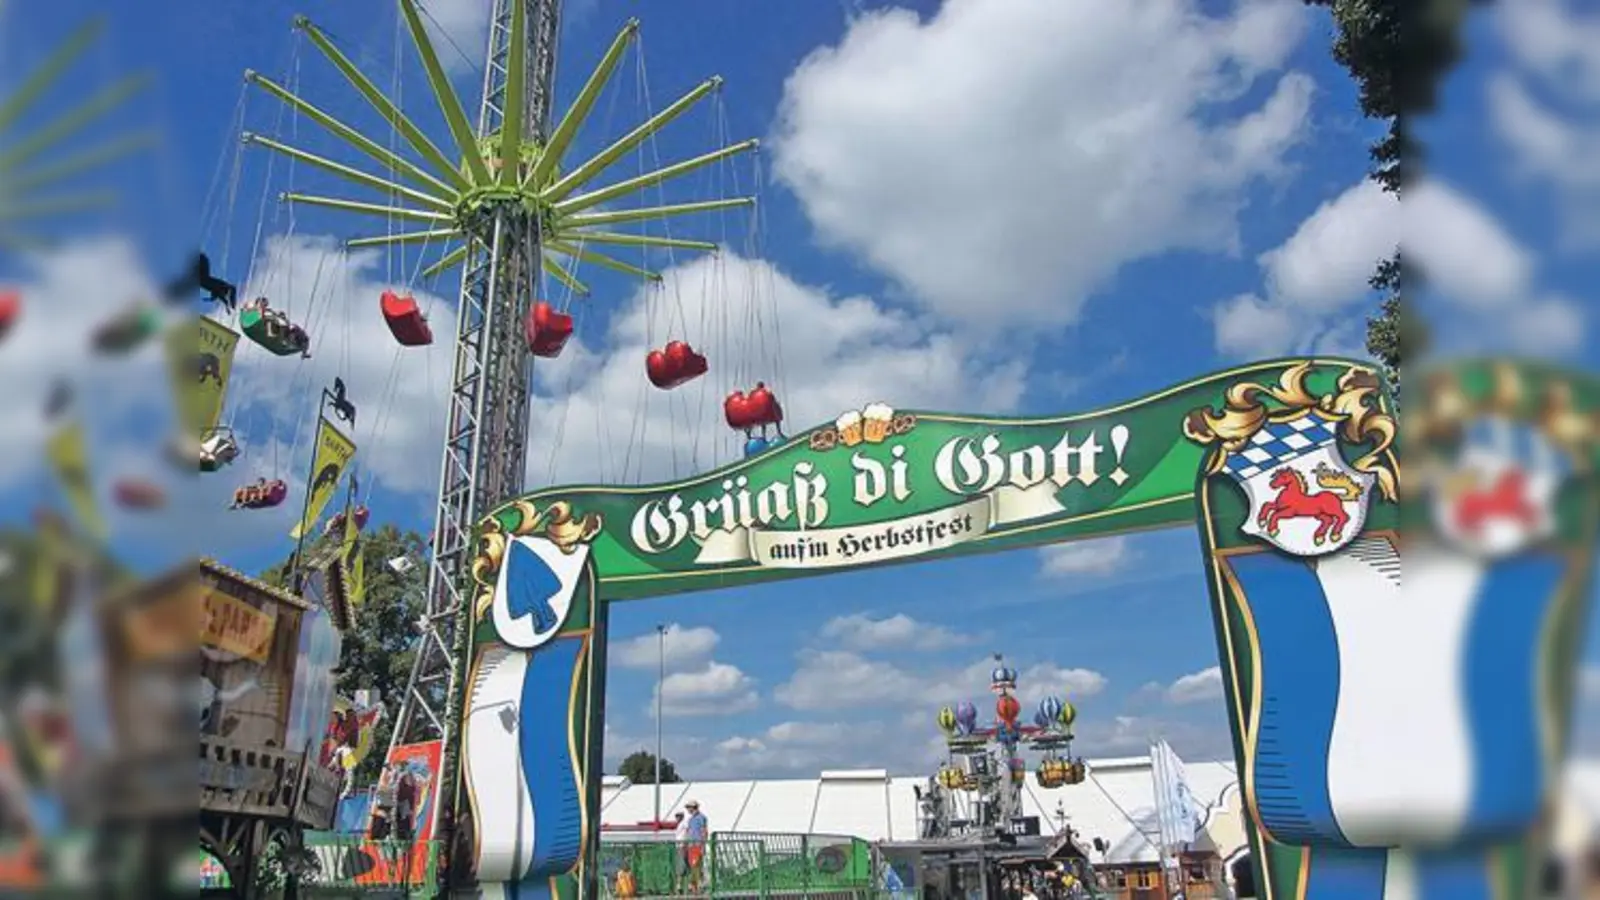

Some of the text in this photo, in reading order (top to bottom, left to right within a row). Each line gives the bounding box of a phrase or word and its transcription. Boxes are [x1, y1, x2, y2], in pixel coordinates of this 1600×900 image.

[631, 424, 1130, 553] Grüaß di Gott!
[836, 513, 972, 558] Herbstfest
